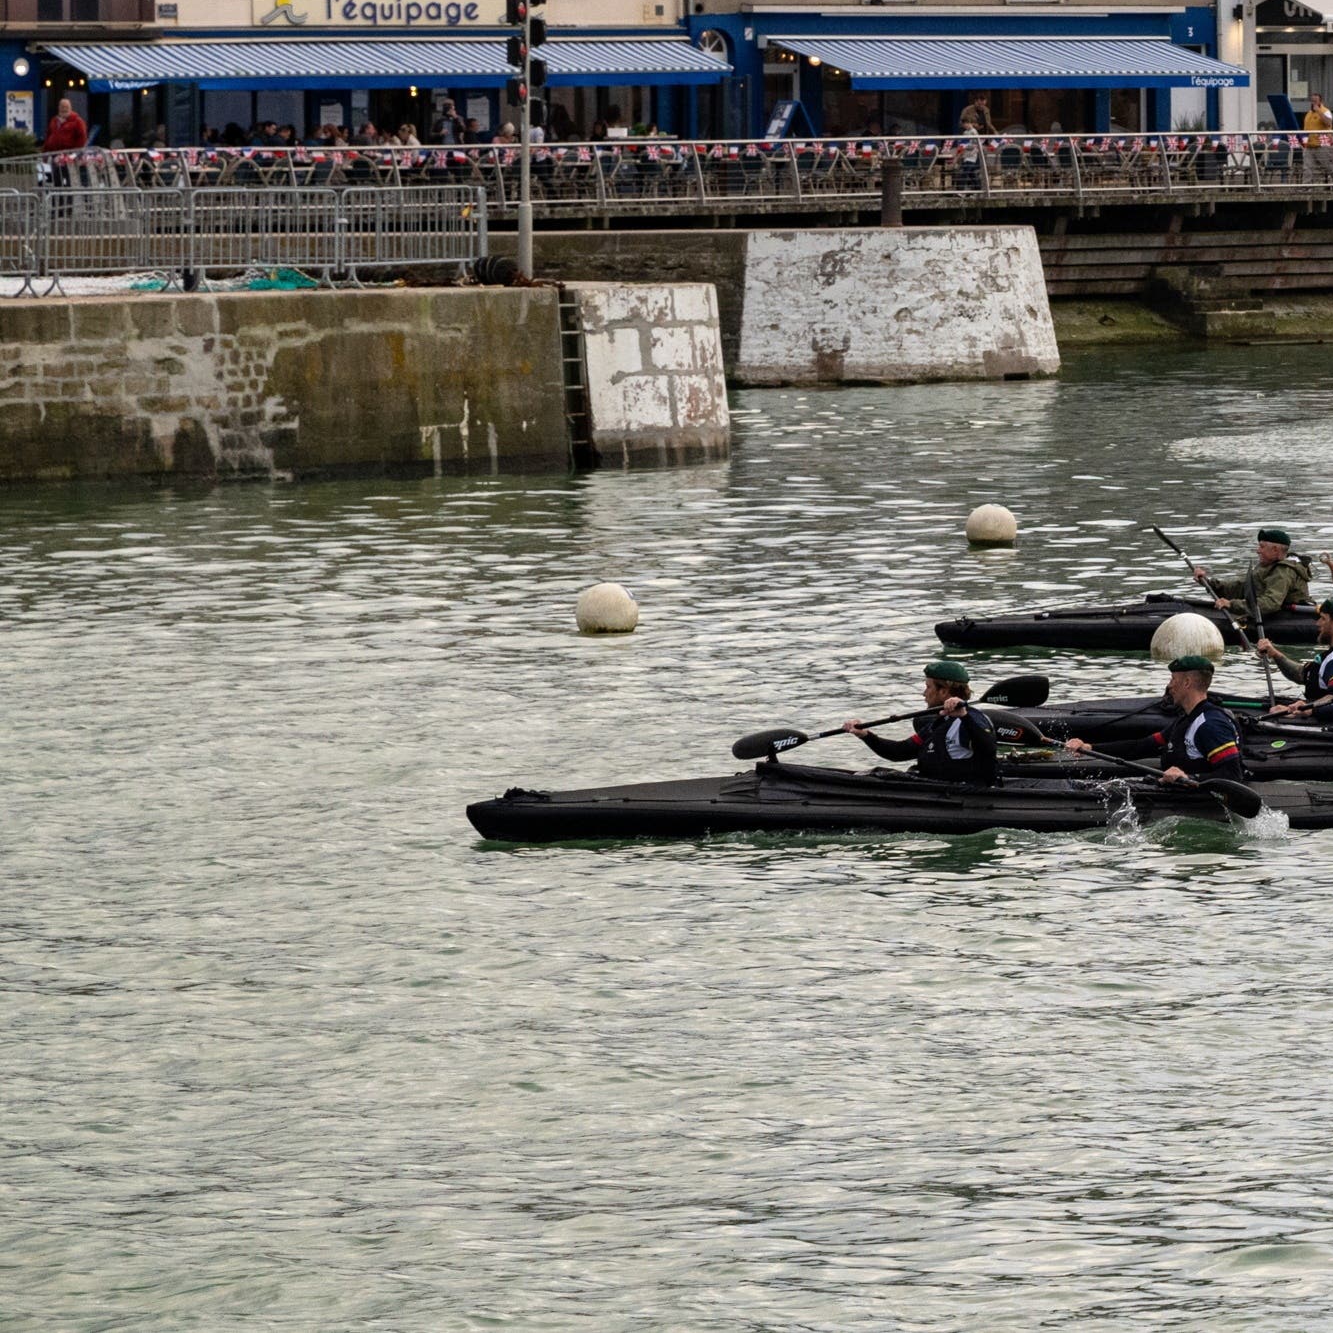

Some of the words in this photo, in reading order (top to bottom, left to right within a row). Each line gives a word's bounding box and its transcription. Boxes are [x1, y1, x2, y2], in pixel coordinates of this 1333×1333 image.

[1187, 26, 1194, 37] 3
[1191, 75, 1235, 88] l'équipage
[997, 727, 1019, 737] epic
